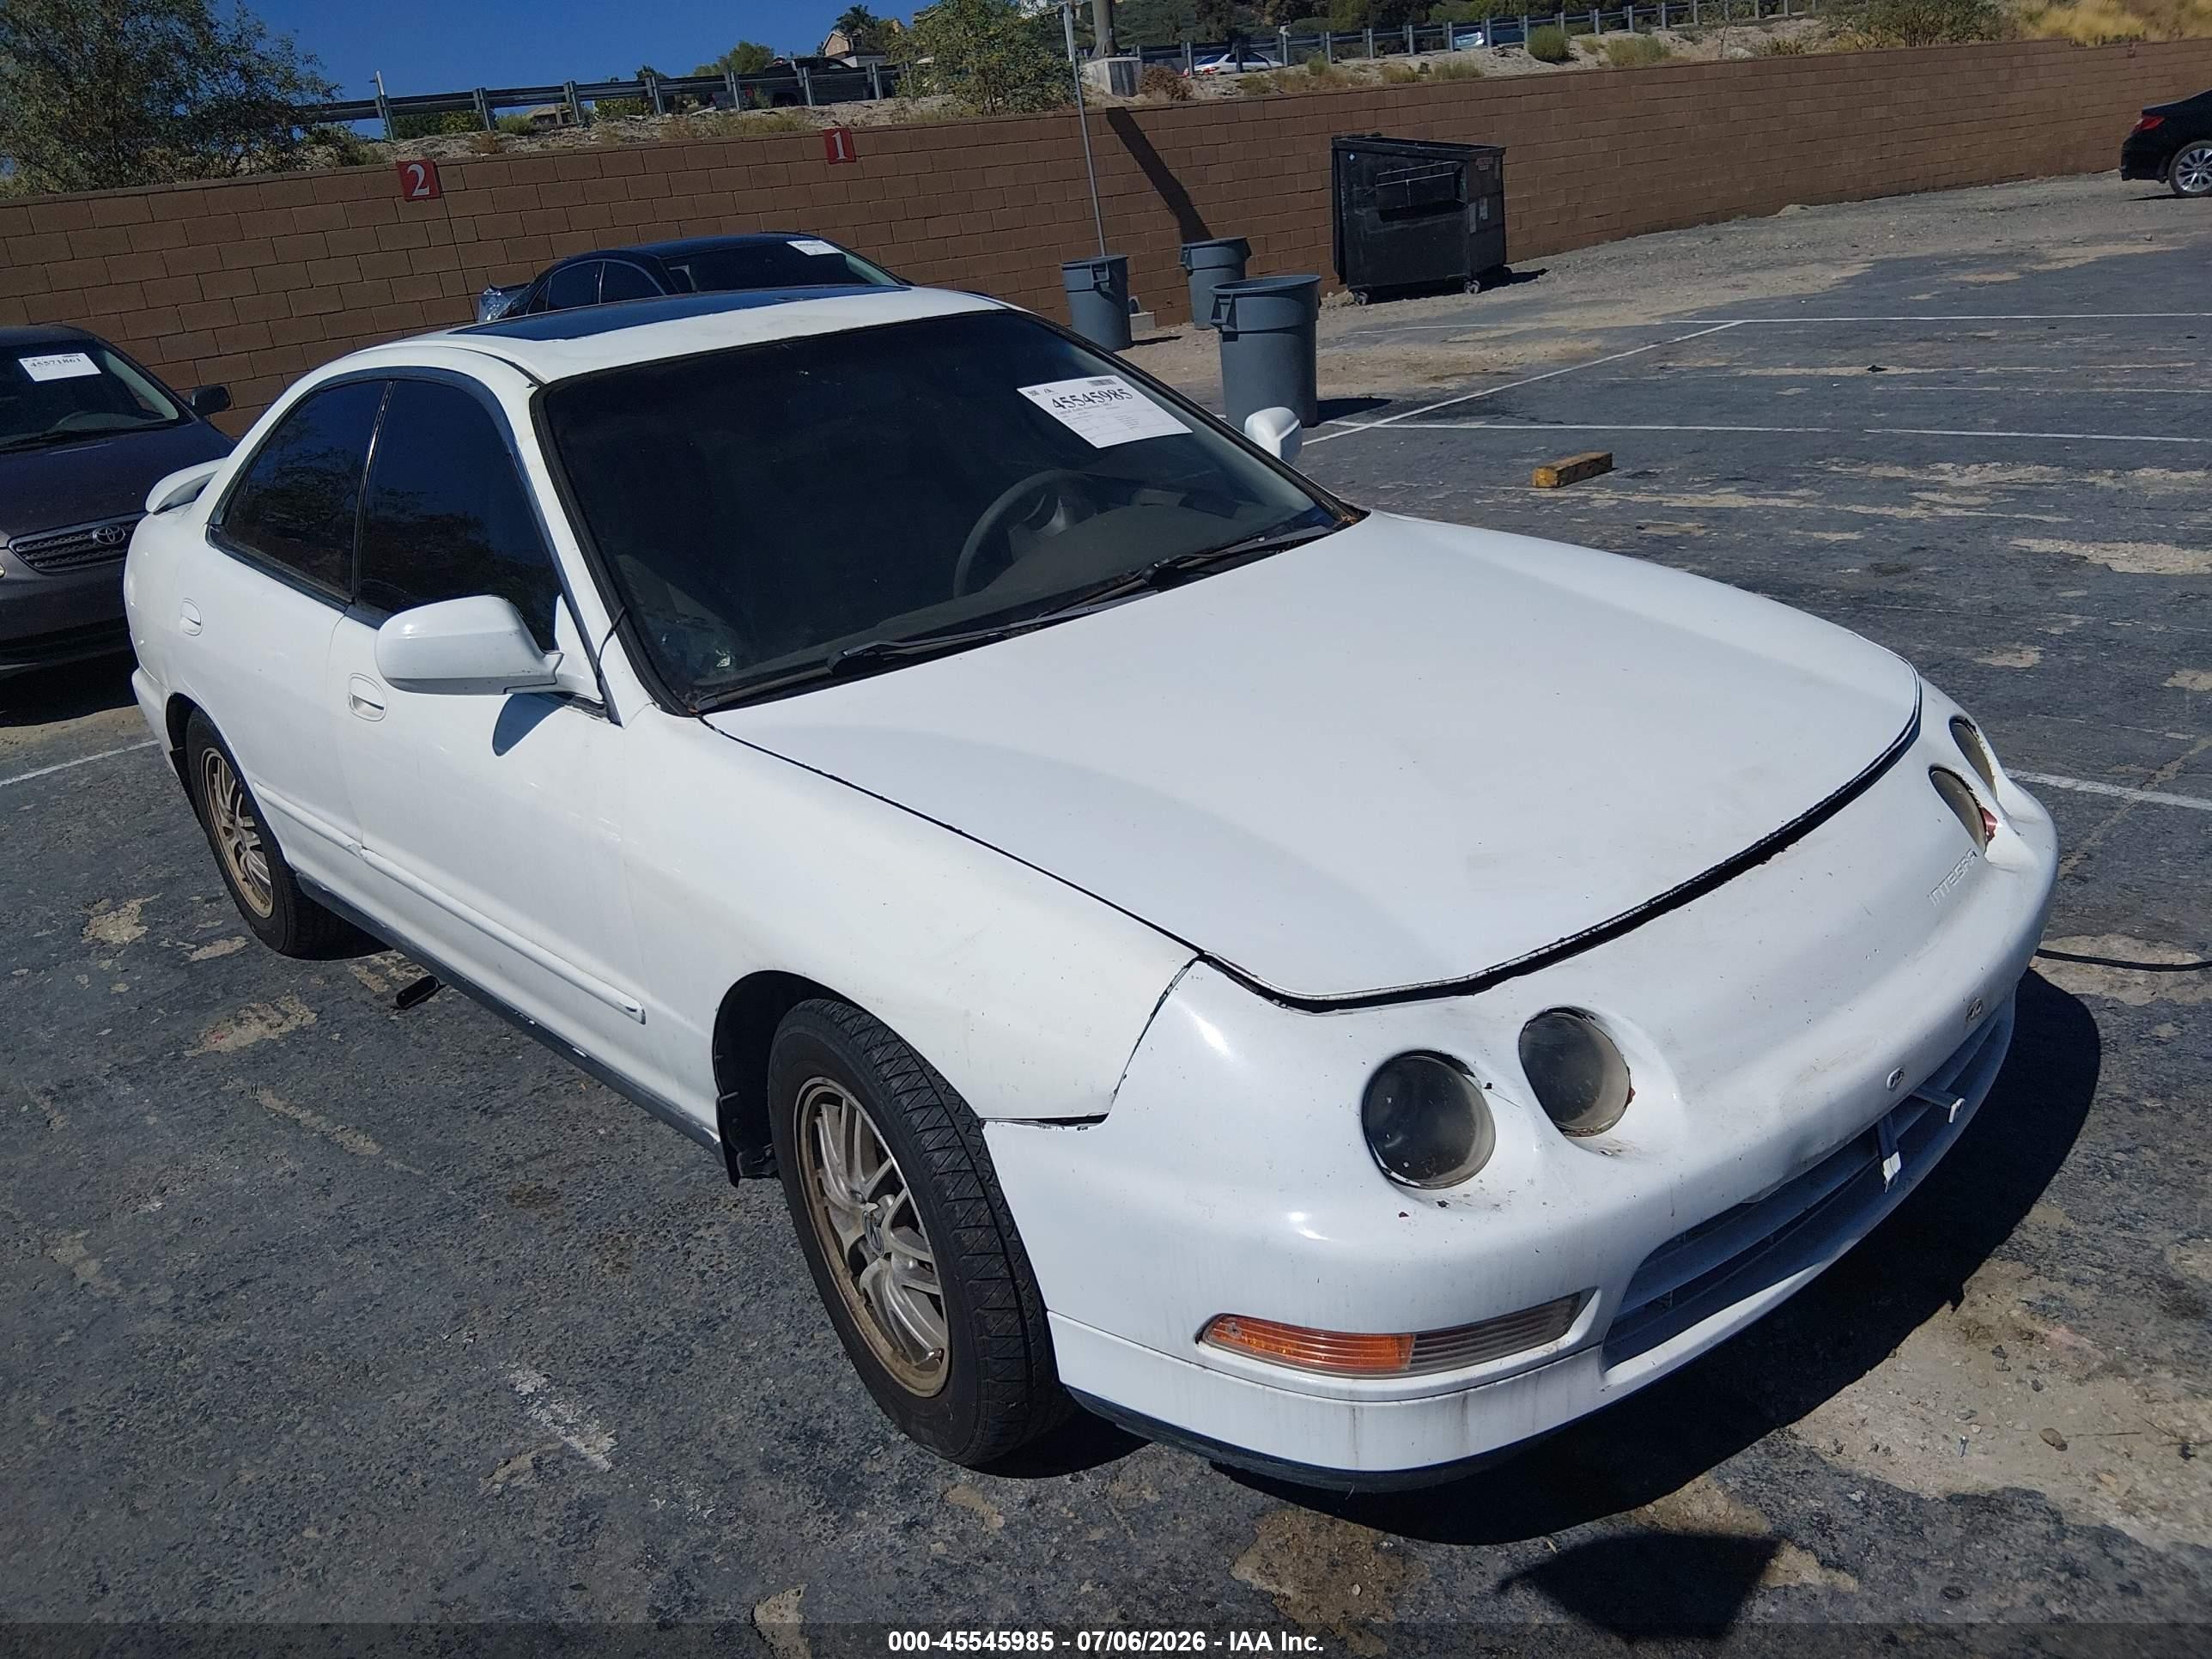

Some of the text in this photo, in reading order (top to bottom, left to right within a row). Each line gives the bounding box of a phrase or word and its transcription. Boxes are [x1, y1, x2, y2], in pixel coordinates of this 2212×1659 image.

[831, 131, 848, 160] 1
[406, 163, 430, 197] 2
[1052, 388, 1133, 410] 45545985
[1927, 848, 1978, 907] INTEGRA
